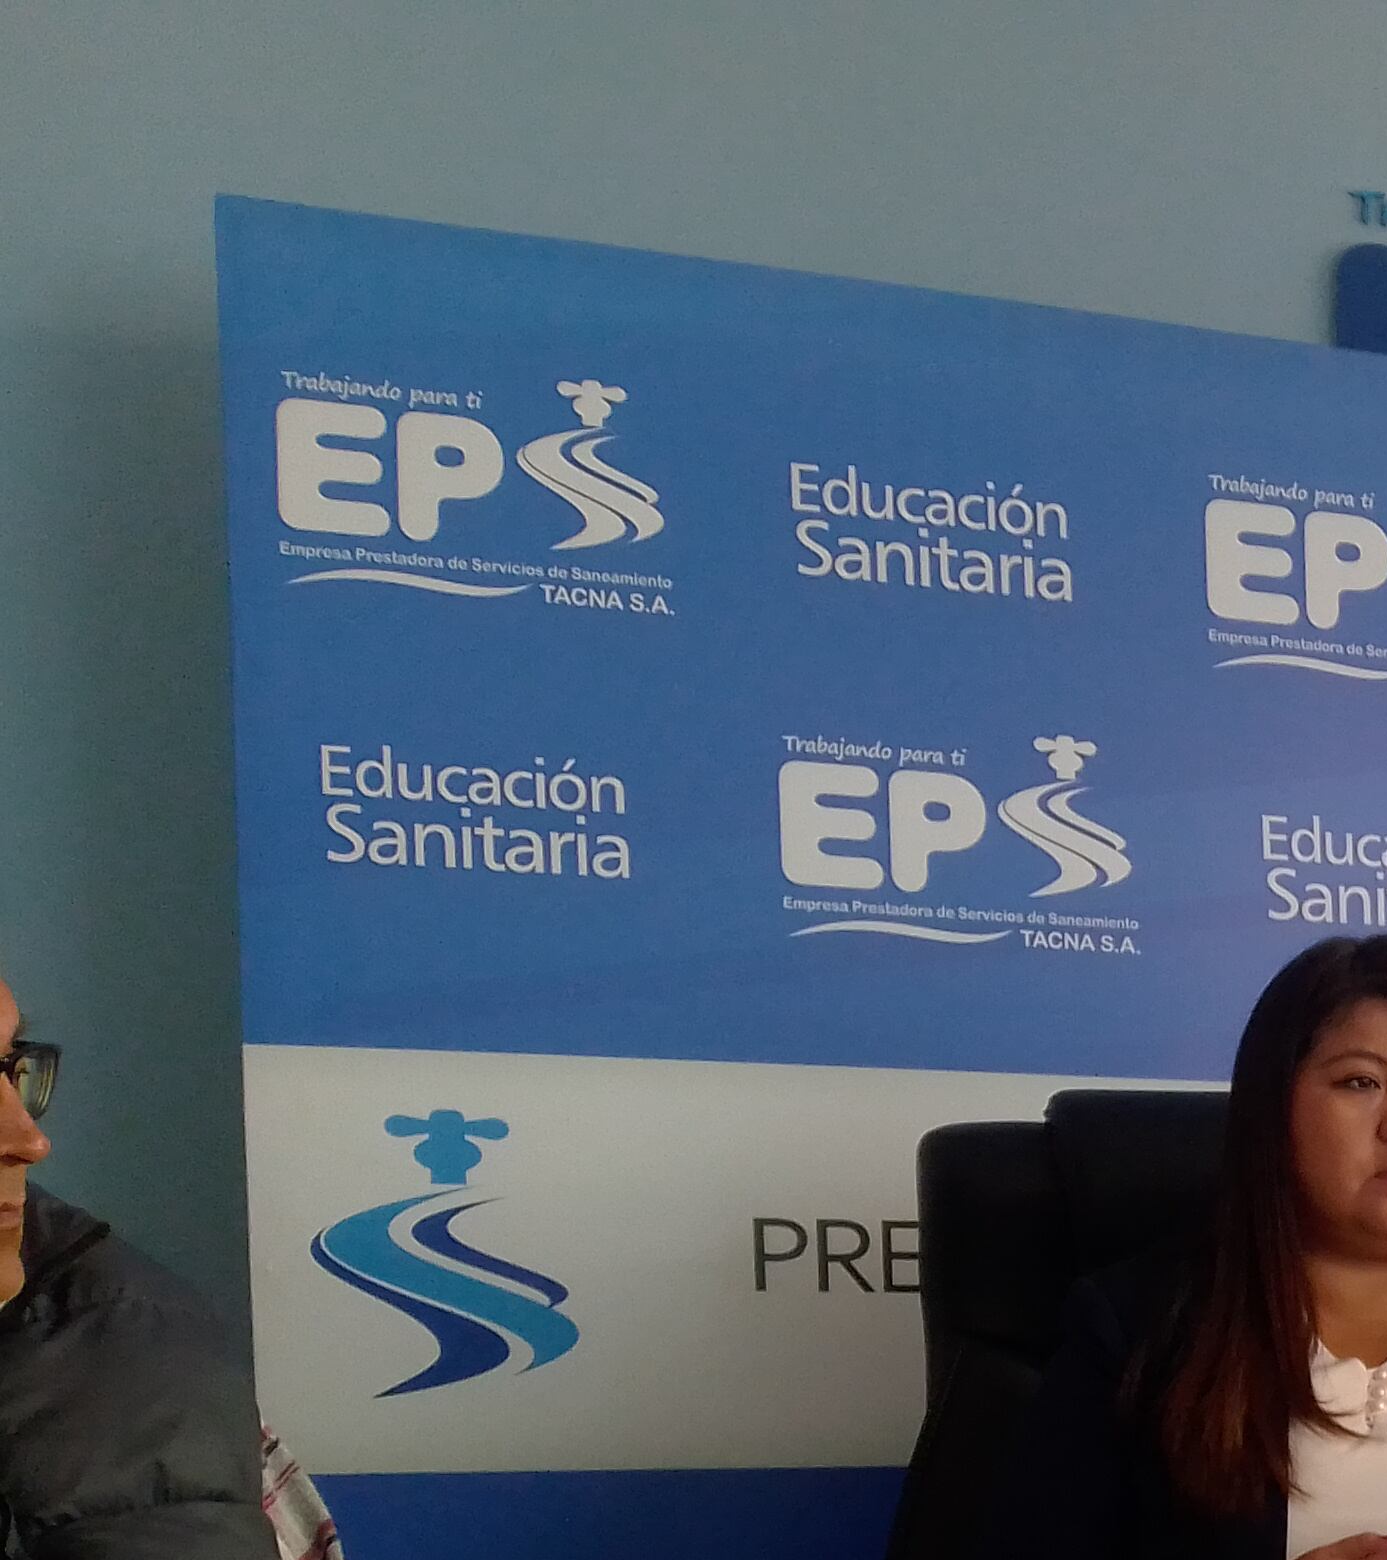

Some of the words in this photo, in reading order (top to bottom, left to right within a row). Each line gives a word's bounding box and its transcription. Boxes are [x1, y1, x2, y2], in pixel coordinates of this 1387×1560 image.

[281, 370, 401, 401] Trabajando
[409, 388, 458, 408] para
[466, 391, 483, 409] ti
[789, 461, 1069, 539] Educación
[1208, 474, 1307, 499] Trabajando
[1314, 490, 1354, 508] para
[1361, 492, 1375, 509] ti
[279, 540, 351, 561] Empresa
[356, 547, 443, 569] Prestadora
[448, 557, 467, 571] de
[471, 558, 543, 577] Servicios
[548, 565, 567, 580] de
[571, 567, 672, 589] Saneamiento
[796, 519, 1073, 601] Sanitaria
[540, 584, 623, 610] TACNA
[630, 594, 675, 616] S.A.
[1208, 629, 1267, 647] Empresa
[1271, 635, 1343, 655] Prestadora
[1346, 643, 1362, 655] de
[782, 735, 892, 760] Trabajando
[900, 747, 943, 767] para
[951, 749, 967, 766] ti
[320, 743, 626, 814] Educación
[325, 802, 631, 880] Sanitaria
[783, 896, 848, 913] Empresa
[852, 900, 933, 918] Prestadora
[937, 907, 954, 919] de
[958, 907, 1023, 924] Servicios
[1027, 911, 1044, 925] de
[1048, 913, 1138, 929] Saneamiento
[1020, 930, 1095, 951] TACNA
[1101, 935, 1141, 955] S.A.
[752, 1217, 921, 1293] PRE
